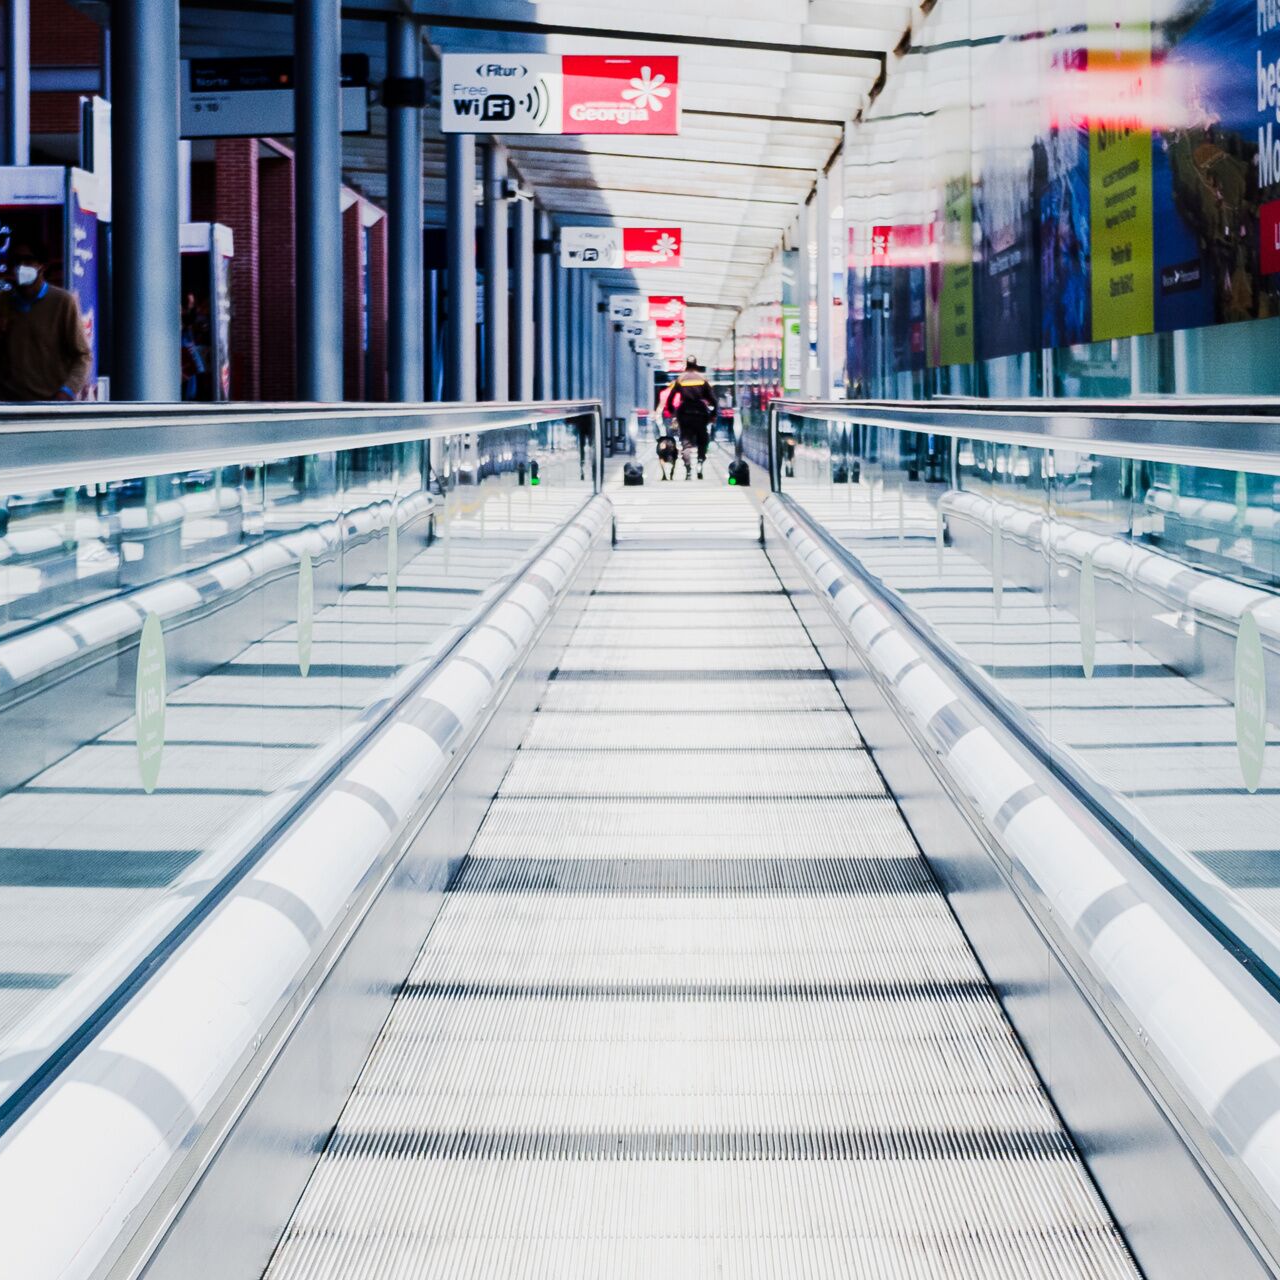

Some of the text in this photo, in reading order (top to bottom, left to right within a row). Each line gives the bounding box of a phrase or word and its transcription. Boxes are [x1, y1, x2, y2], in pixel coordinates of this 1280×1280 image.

[486, 64, 517, 77] Fitur
[453, 83, 488, 96] Free
[569, 103, 649, 125] Georgia
